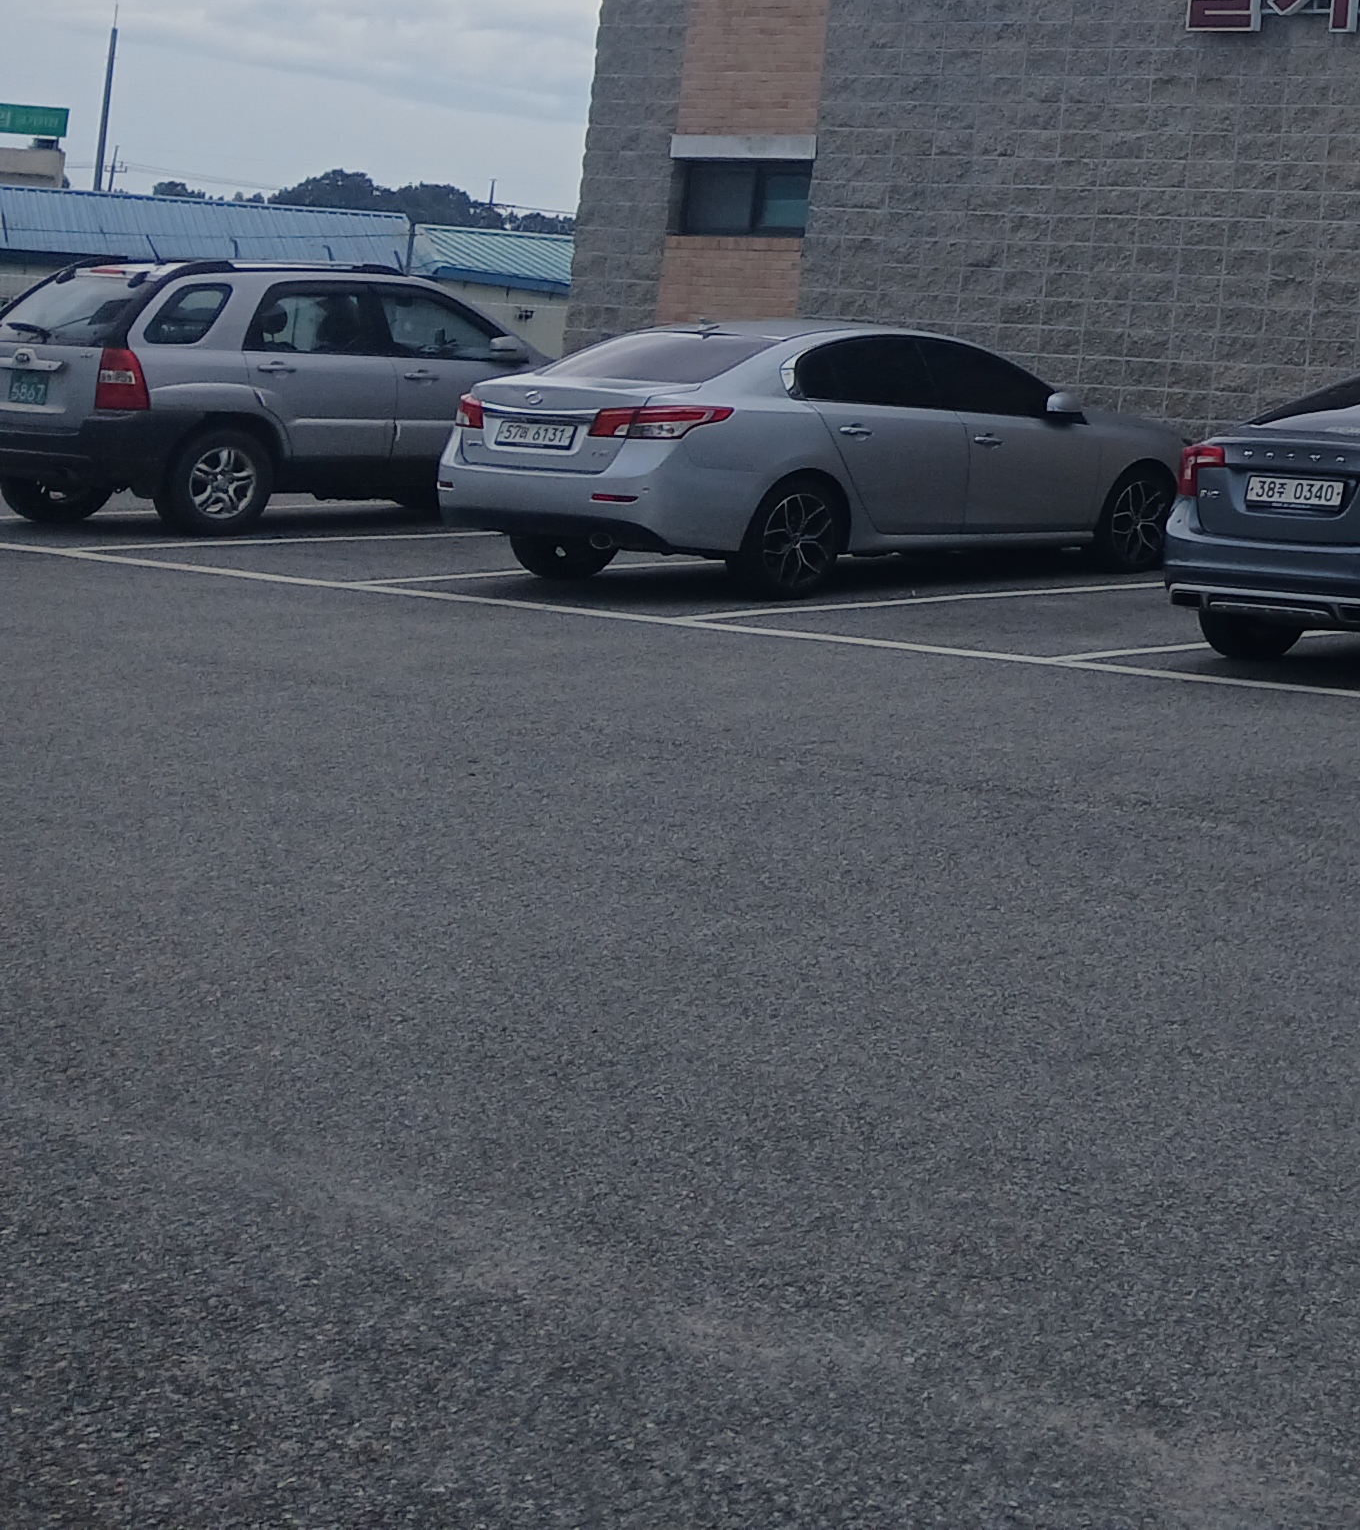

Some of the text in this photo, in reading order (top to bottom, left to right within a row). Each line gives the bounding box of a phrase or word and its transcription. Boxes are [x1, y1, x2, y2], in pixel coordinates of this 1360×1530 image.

[532, 425, 567, 444] 6131
[1255, 480, 1335, 502] 38주 0340
